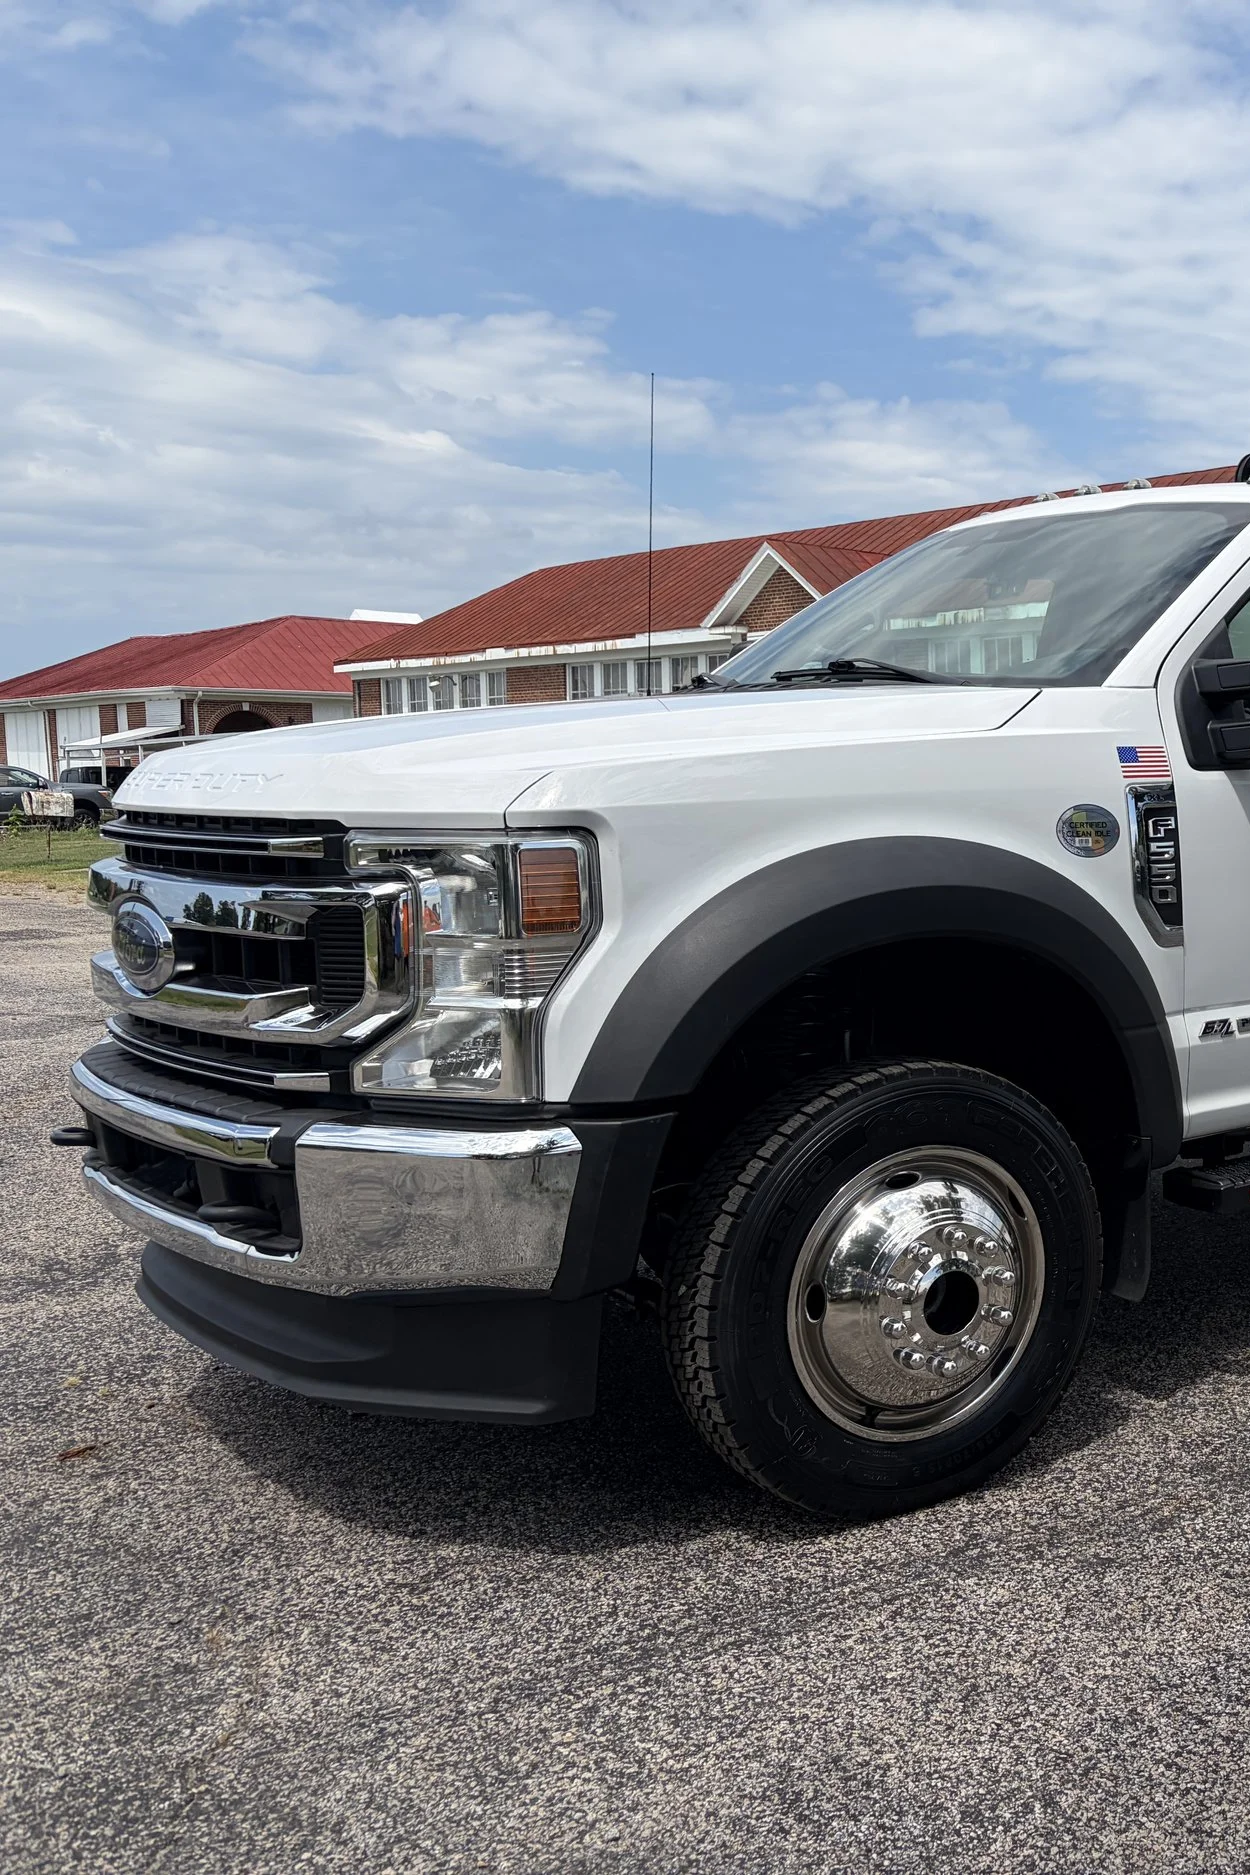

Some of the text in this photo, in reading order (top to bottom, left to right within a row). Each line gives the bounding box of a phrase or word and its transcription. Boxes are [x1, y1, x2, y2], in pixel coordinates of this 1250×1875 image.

[191, 772, 284, 793] DUTY
[1069, 821, 1108, 829] CERTIFIED
[1066, 830, 1092, 838] CLEAN
